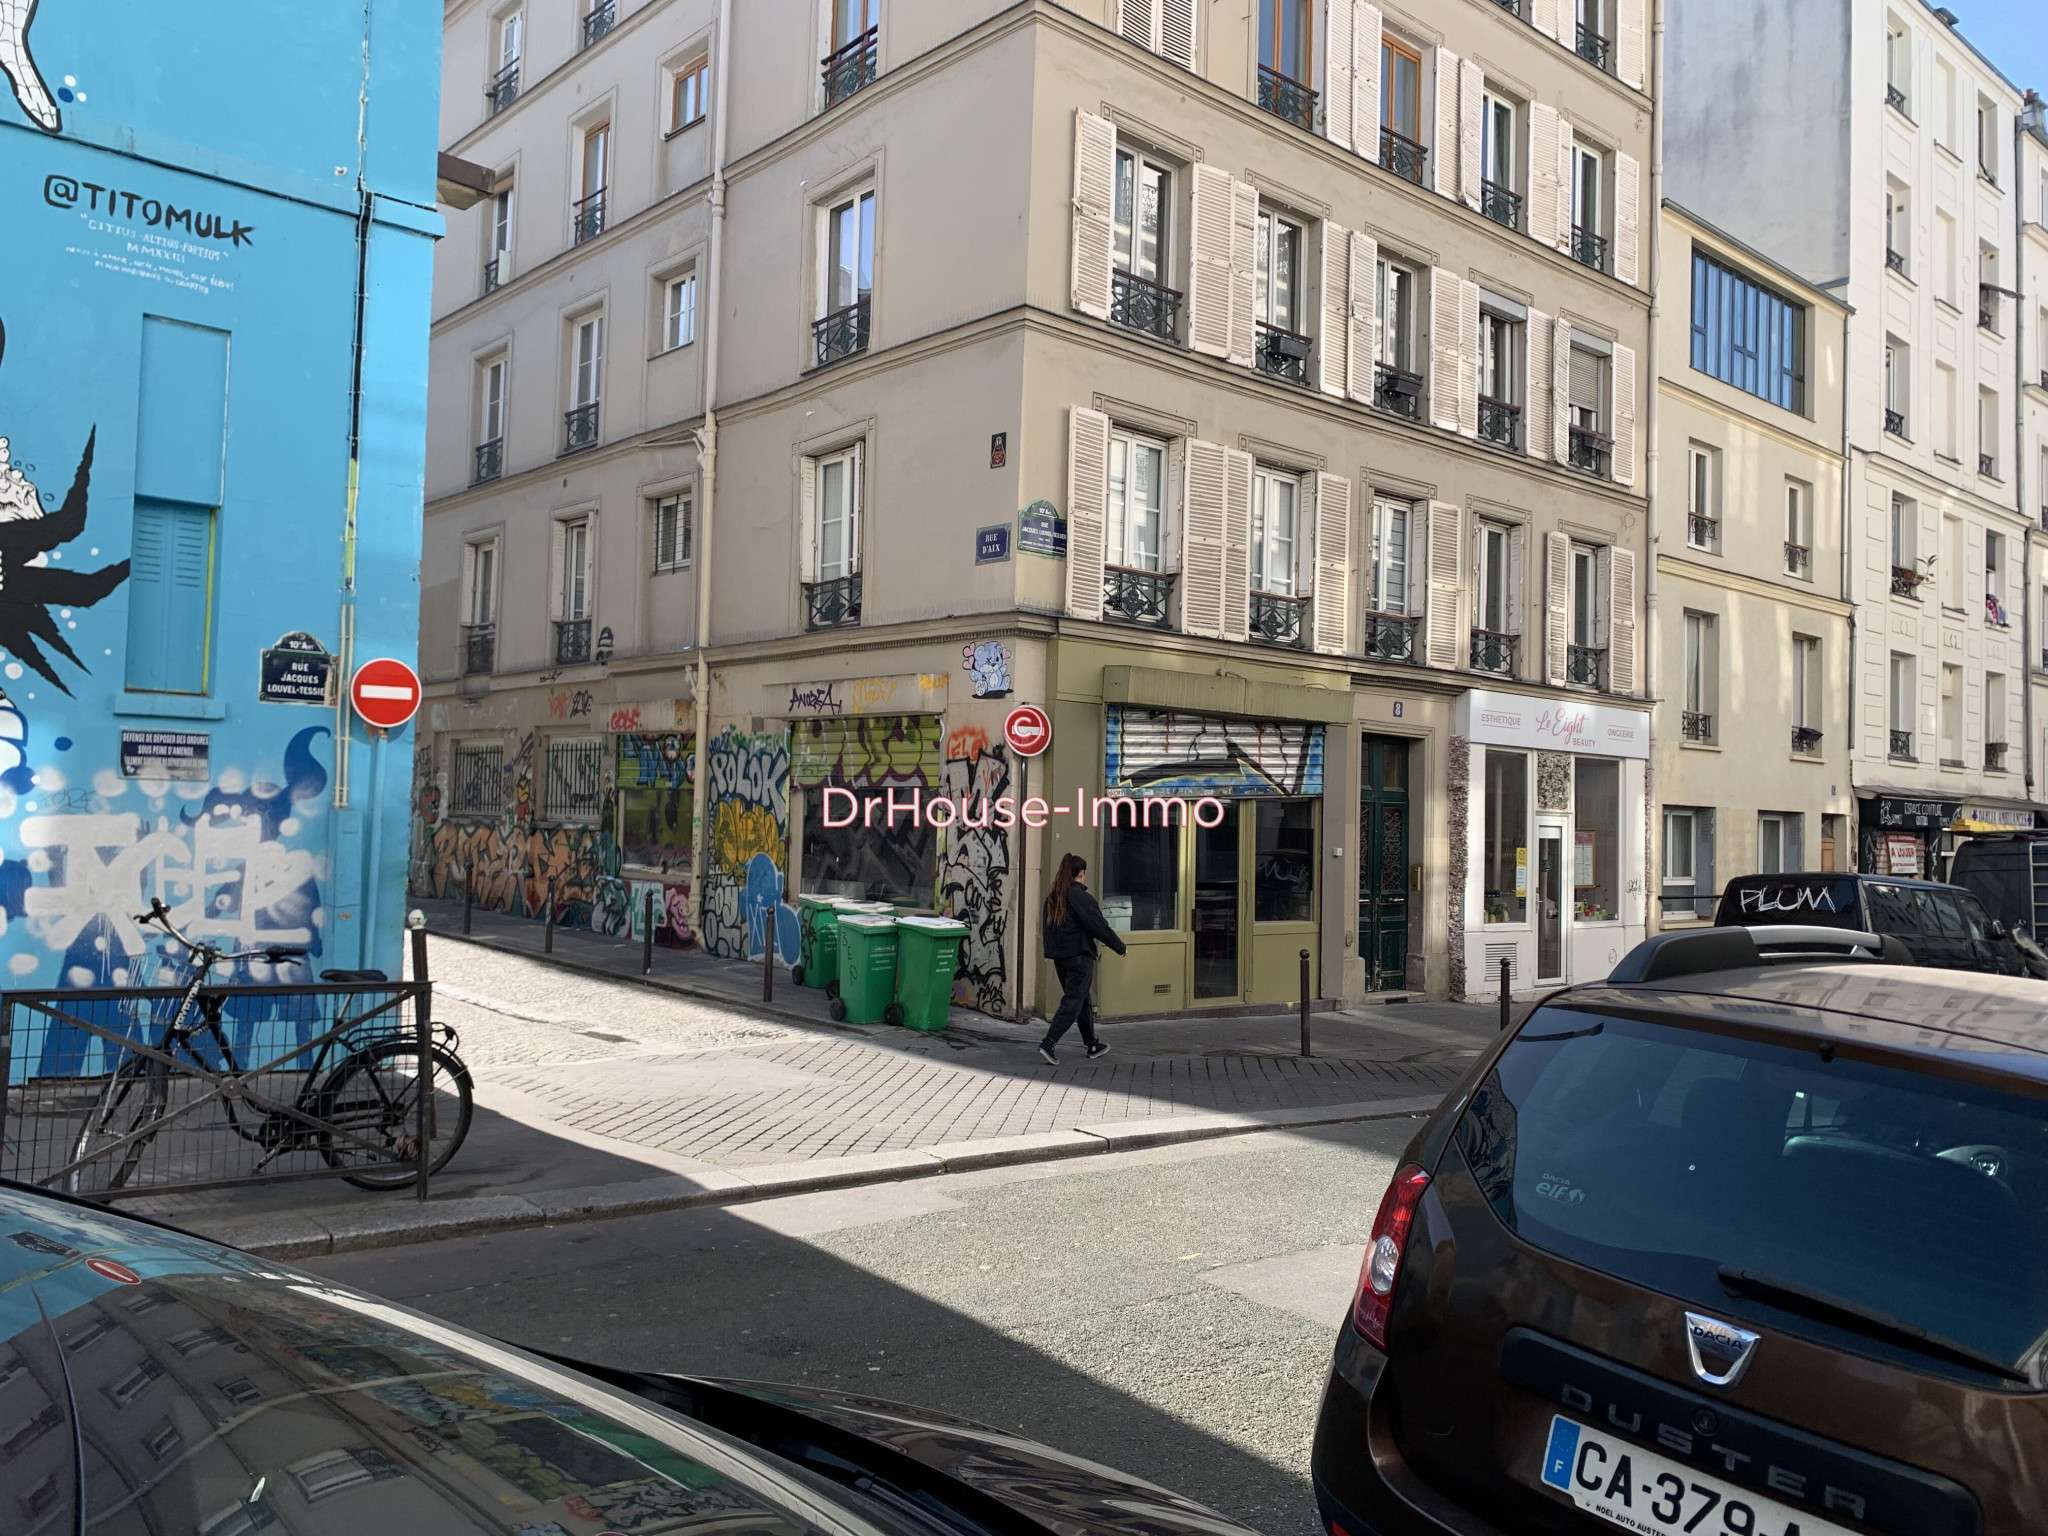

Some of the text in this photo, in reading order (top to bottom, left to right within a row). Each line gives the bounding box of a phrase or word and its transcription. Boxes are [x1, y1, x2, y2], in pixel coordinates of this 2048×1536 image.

[44, 174, 256, 249] @TITOMULK
[984, 533, 999, 543] RUE
[982, 543, 1001, 554] D'AIX
[291, 662, 310, 672] RUE
[280, 672, 319, 684] JACQUES
[267, 683, 327, 696] LOUVEL-TESSIE
[1395, 703, 1401, 716] 8
[1535, 707, 1590, 746] Le Eight
[145, 733, 153, 743] DE
[1571, 736, 1597, 748] BEAUTY
[137, 744, 152, 754] SOUS
[151, 745, 168, 756] PEINE
[1740, 884, 1836, 913] PLUM
[1535, 1182, 1569, 1199] elf
[1693, 1326, 1743, 1351] DACIA
[1561, 1384, 1867, 1520] DUSTER
[1553, 1459, 1564, 1473] F
[1575, 1440, 1801, 1536] CA-379-
[1595, 1503, 1614, 1519] NOEL
[1615, 1513, 1636, 1528] AUTO
